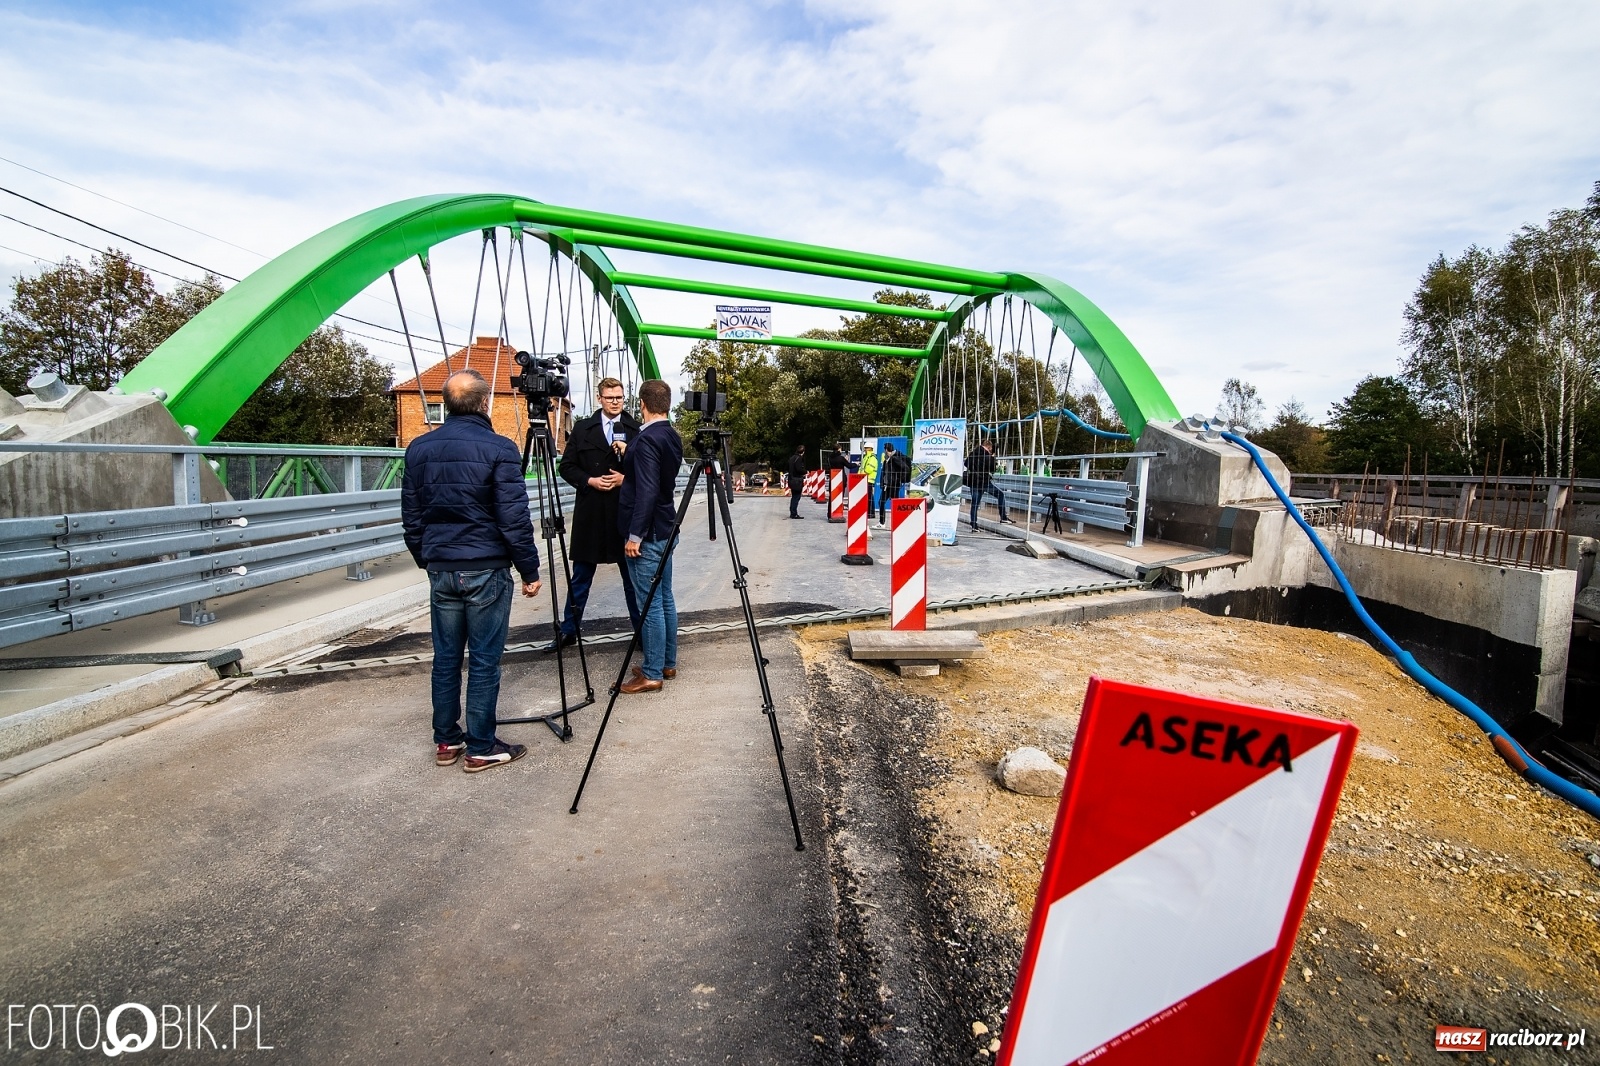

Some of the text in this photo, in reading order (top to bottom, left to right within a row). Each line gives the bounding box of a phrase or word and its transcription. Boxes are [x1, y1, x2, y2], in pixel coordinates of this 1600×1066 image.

[720, 315, 768, 330] NOWAK
[725, 330, 764, 338] MOSTY
[920, 424, 958, 437] NOWAK
[923, 437, 954, 445] MOSTY
[1119, 711, 1293, 773] ASEKA
